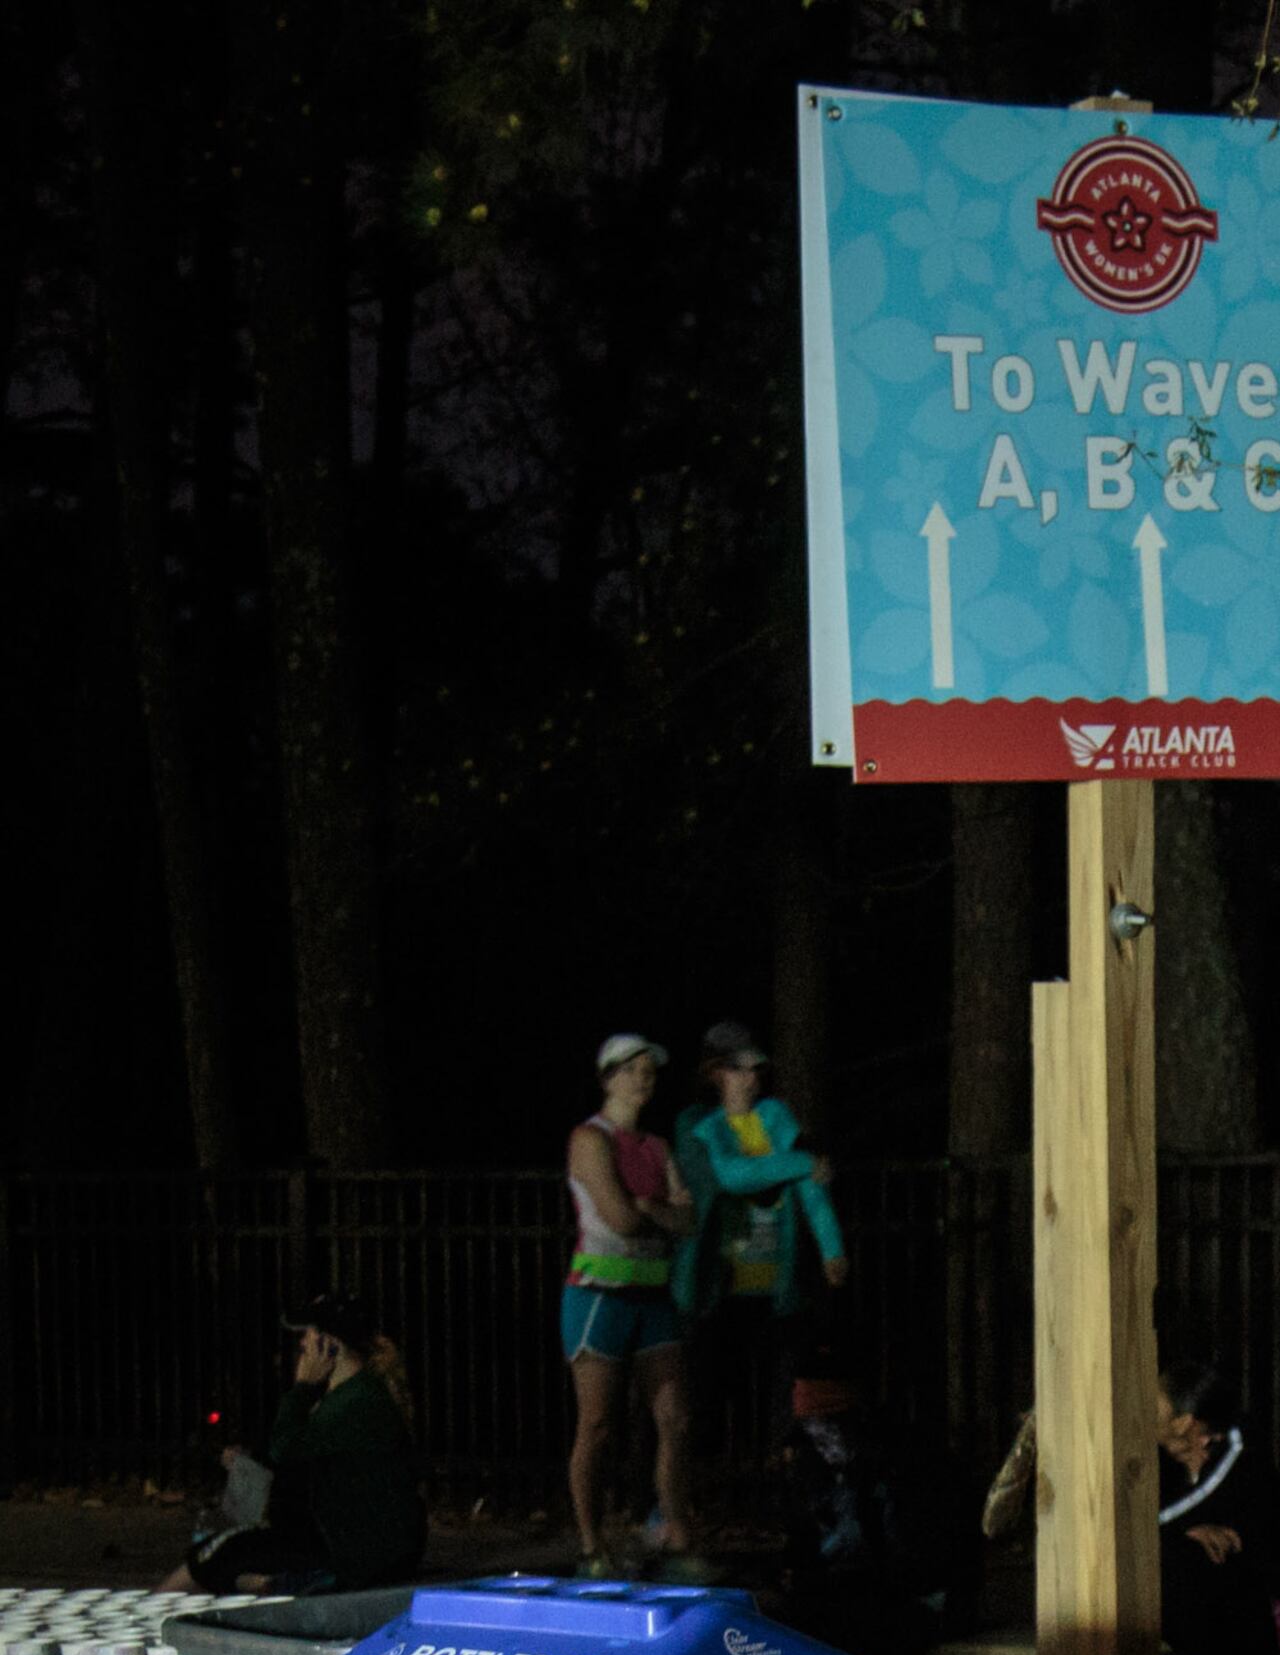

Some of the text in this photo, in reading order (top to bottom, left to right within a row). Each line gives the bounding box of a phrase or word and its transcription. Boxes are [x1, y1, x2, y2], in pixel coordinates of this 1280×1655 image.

[1090, 172, 1161, 203] ATLANTA
[1085, 239, 1154, 281] WOMEN'S
[934, 334, 1035, 414] To
[976, 433, 1058, 527] A,
[1085, 435, 1135, 511] B
[1162, 437, 1223, 513] &
[1122, 725, 1236, 754] ATLANTA
[1123, 755, 1236, 768] TRACK CLUB
